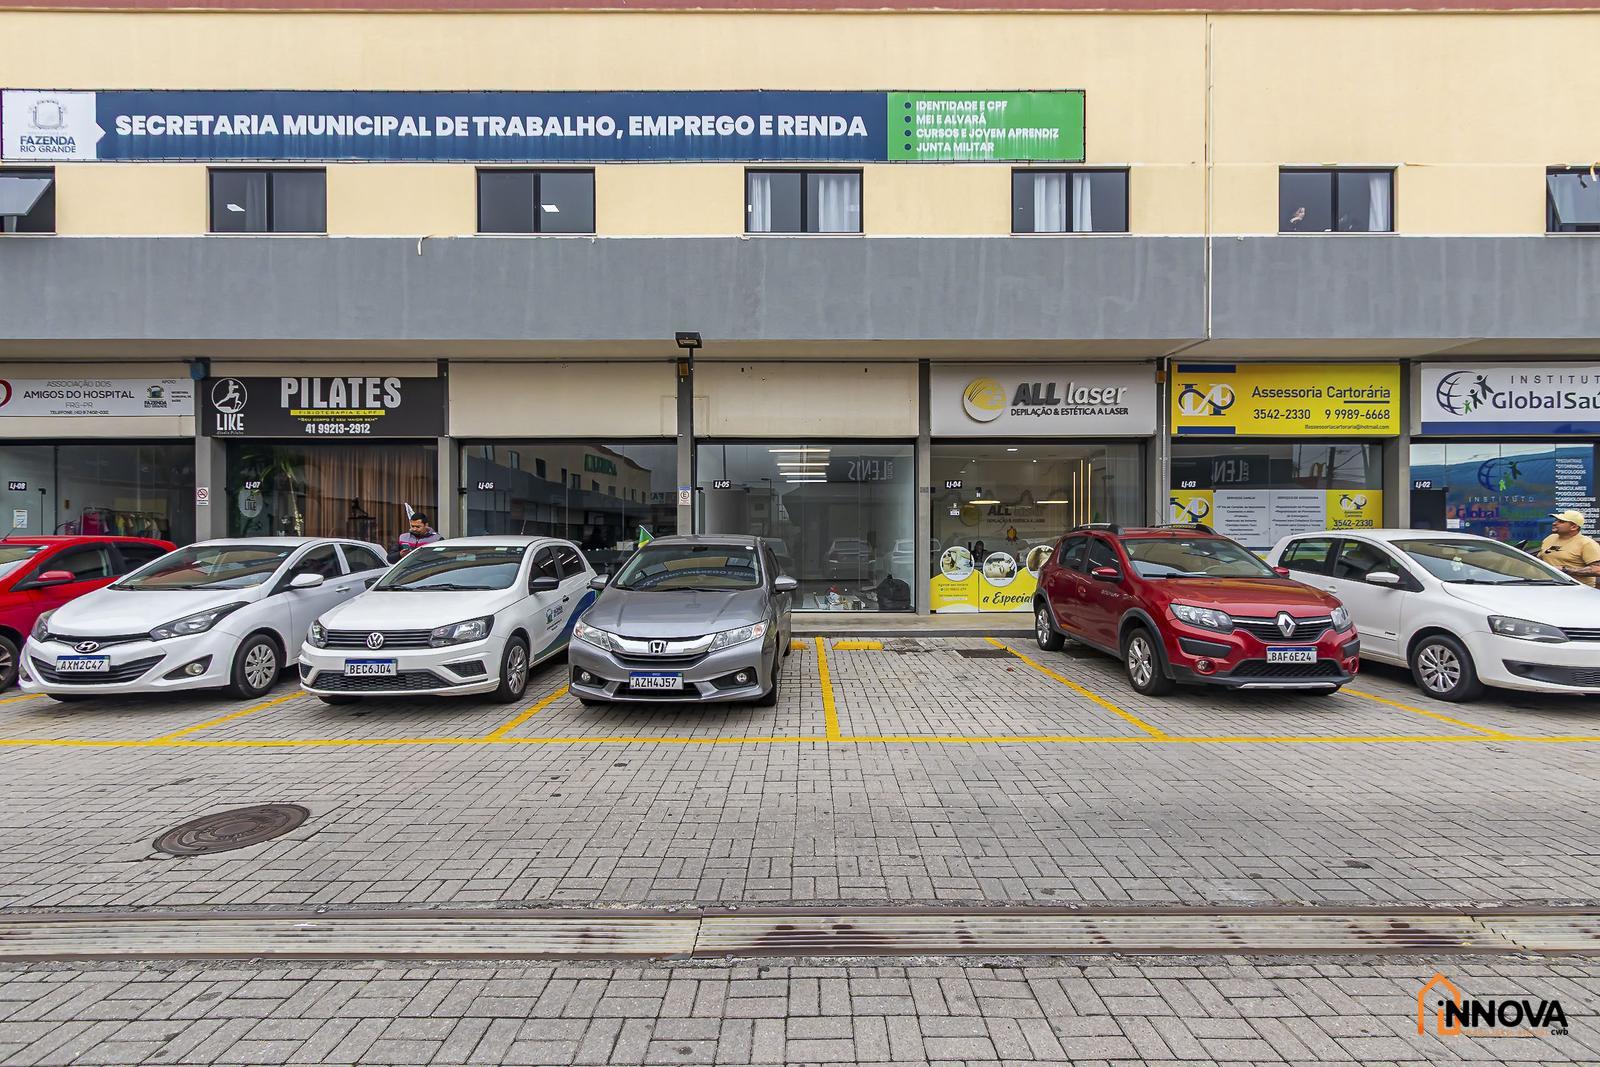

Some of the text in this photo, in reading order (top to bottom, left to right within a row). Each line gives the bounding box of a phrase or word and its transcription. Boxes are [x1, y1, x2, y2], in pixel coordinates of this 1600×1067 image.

[916, 101, 1008, 111] IDENTIDADE E CPF
[916, 112, 986, 124] MEI E ALVARÁ
[115, 114, 868, 139] SECRETARIA MUNICIPAL DE TRABALHO, EMPREGO E RENDA
[916, 128, 1059, 138] CURSOS E JOVEM APRENDIZ
[20, 136, 76, 145] FAZENDA
[20, 145, 76, 153] RIO GRANDE
[916, 142, 994, 151] JUNTA MILITAR
[46, 380, 111, 389] ASSOCIAÇÃO DOS
[23, 390, 135, 399] AMIGOS DO HOSPITAL
[281, 377, 401, 408] PILATES
[1012, 382, 1128, 406] ALL laser
[1252, 385, 1390, 398] Assessoria Cartorária
[1011, 407, 1052, 417] DEPILAÇÃO
[1061, 406, 1096, 415] ESTÉTICA
[1253, 409, 1390, 419] 3542-2330 9 9989-6668
[216, 413, 244, 431] LIKE
[305, 423, 370, 434] 41 99213-2912
[1271, 652, 1312, 662] BAF6E24
[60, 660, 104, 670] AXM2C47
[349, 664, 391, 674] BEC6J04
[634, 677, 677, 688] AZH4J57
